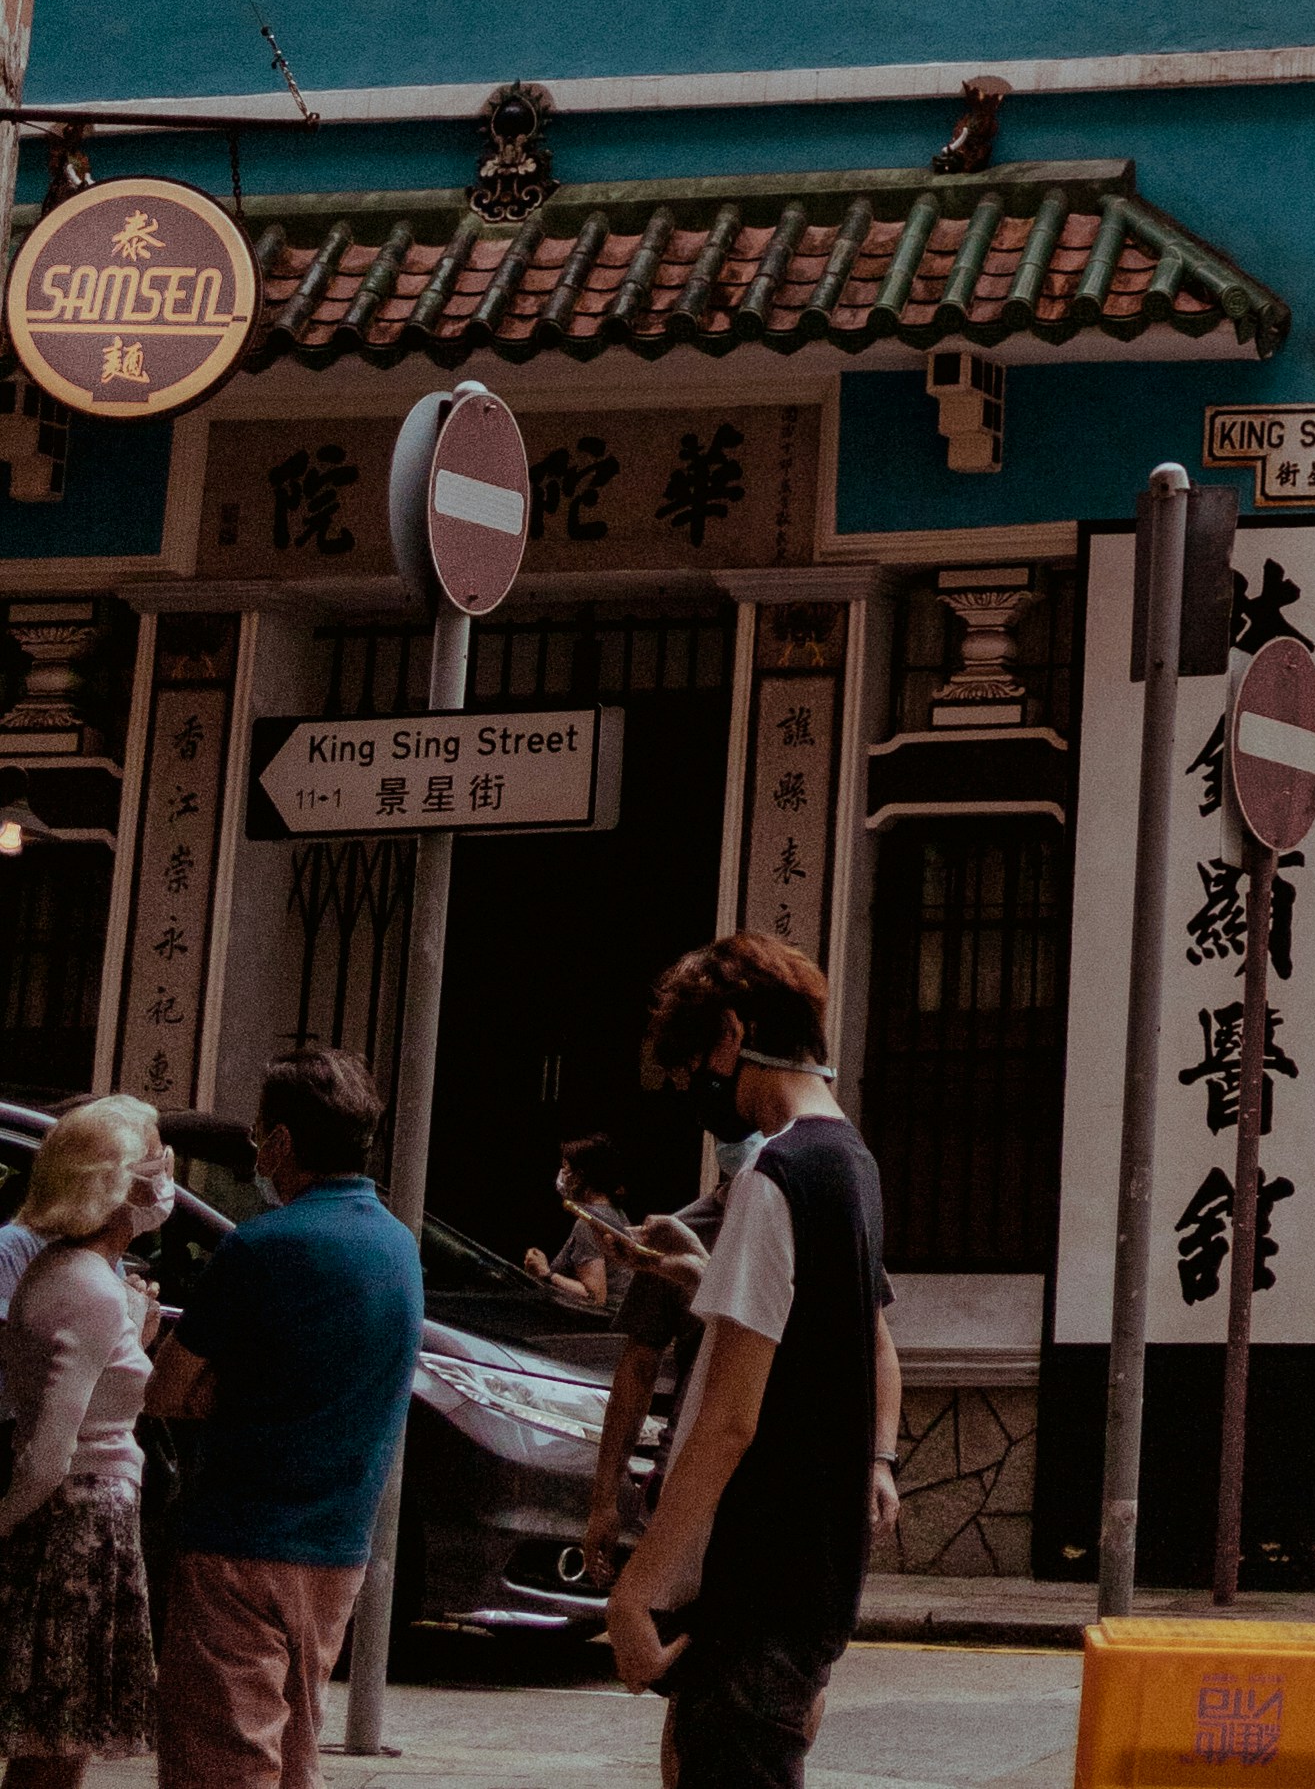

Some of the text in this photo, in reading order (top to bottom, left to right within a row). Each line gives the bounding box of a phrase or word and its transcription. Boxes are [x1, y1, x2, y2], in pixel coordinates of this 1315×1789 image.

[111, 210, 166, 261] 泰
[34, 264, 230, 322] SAMSEN
[1220, 421, 1285, 449] KING
[309, 724, 578, 767] King Sing Street
[375, 774, 505, 816] 景星街
